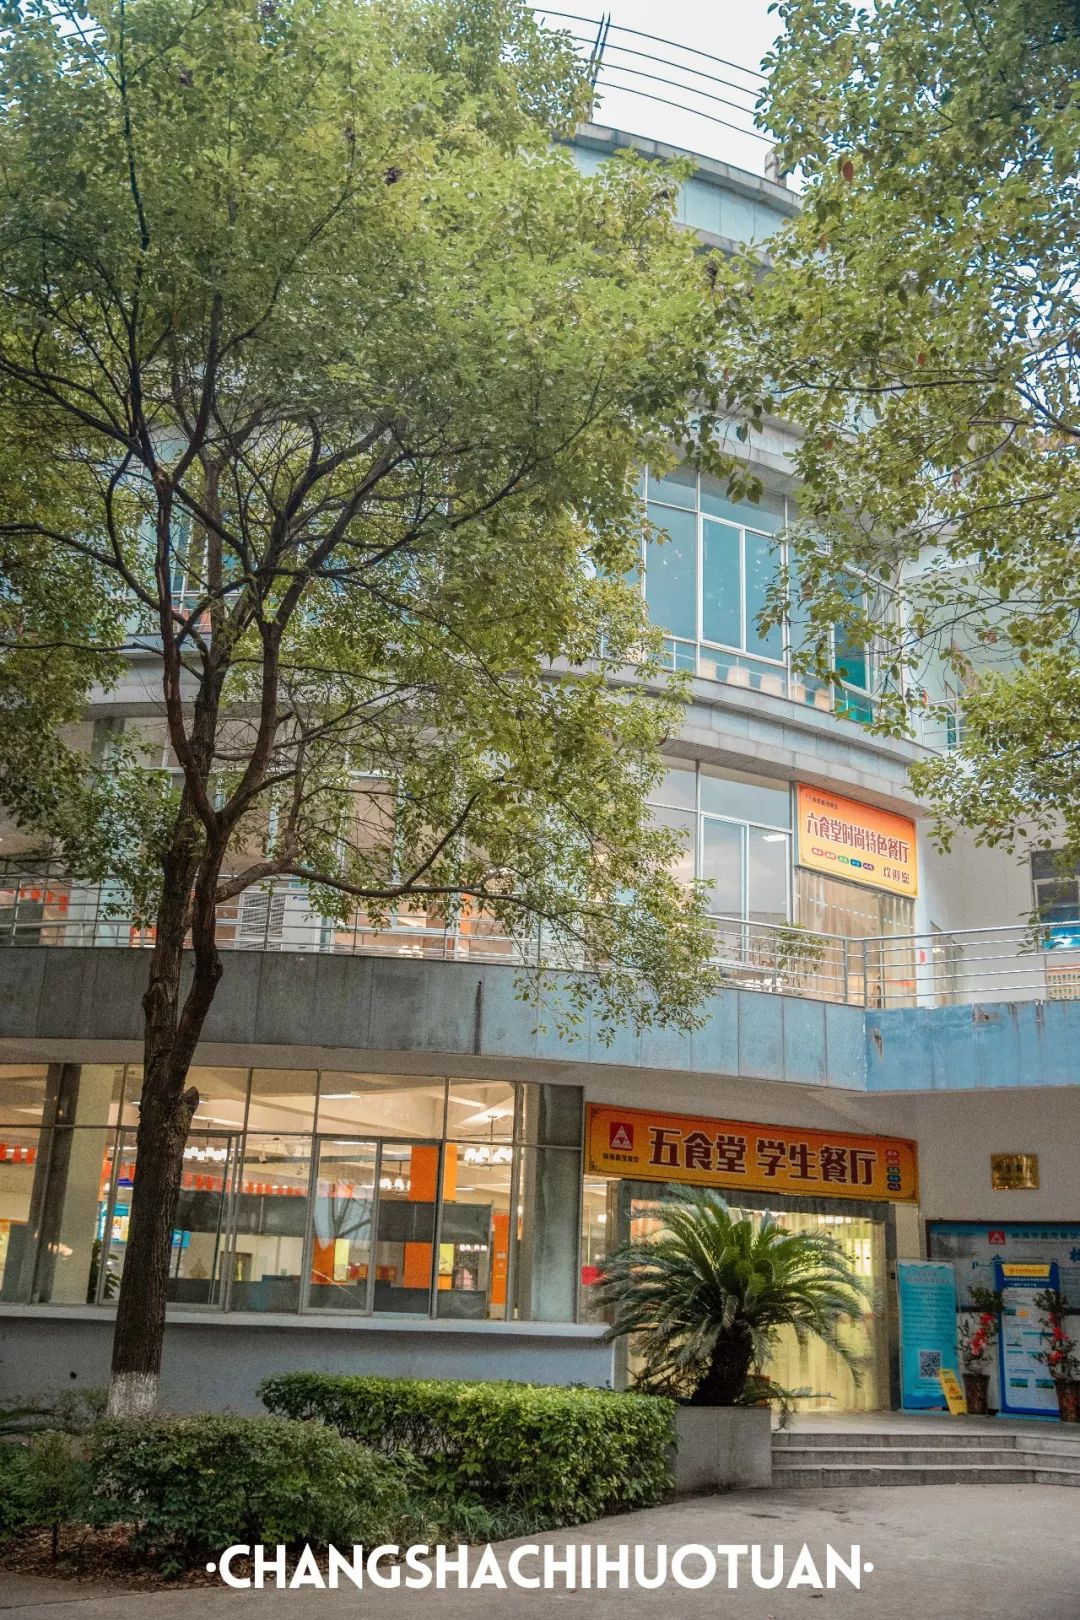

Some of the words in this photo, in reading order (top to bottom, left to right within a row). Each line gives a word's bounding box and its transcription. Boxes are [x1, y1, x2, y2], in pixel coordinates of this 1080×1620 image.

[806, 812, 909, 864] 六食堂时尚特色餐厅
[648, 1127, 747, 1174] 五食堂
[756, 1138, 877, 1186] 学生餐厅
